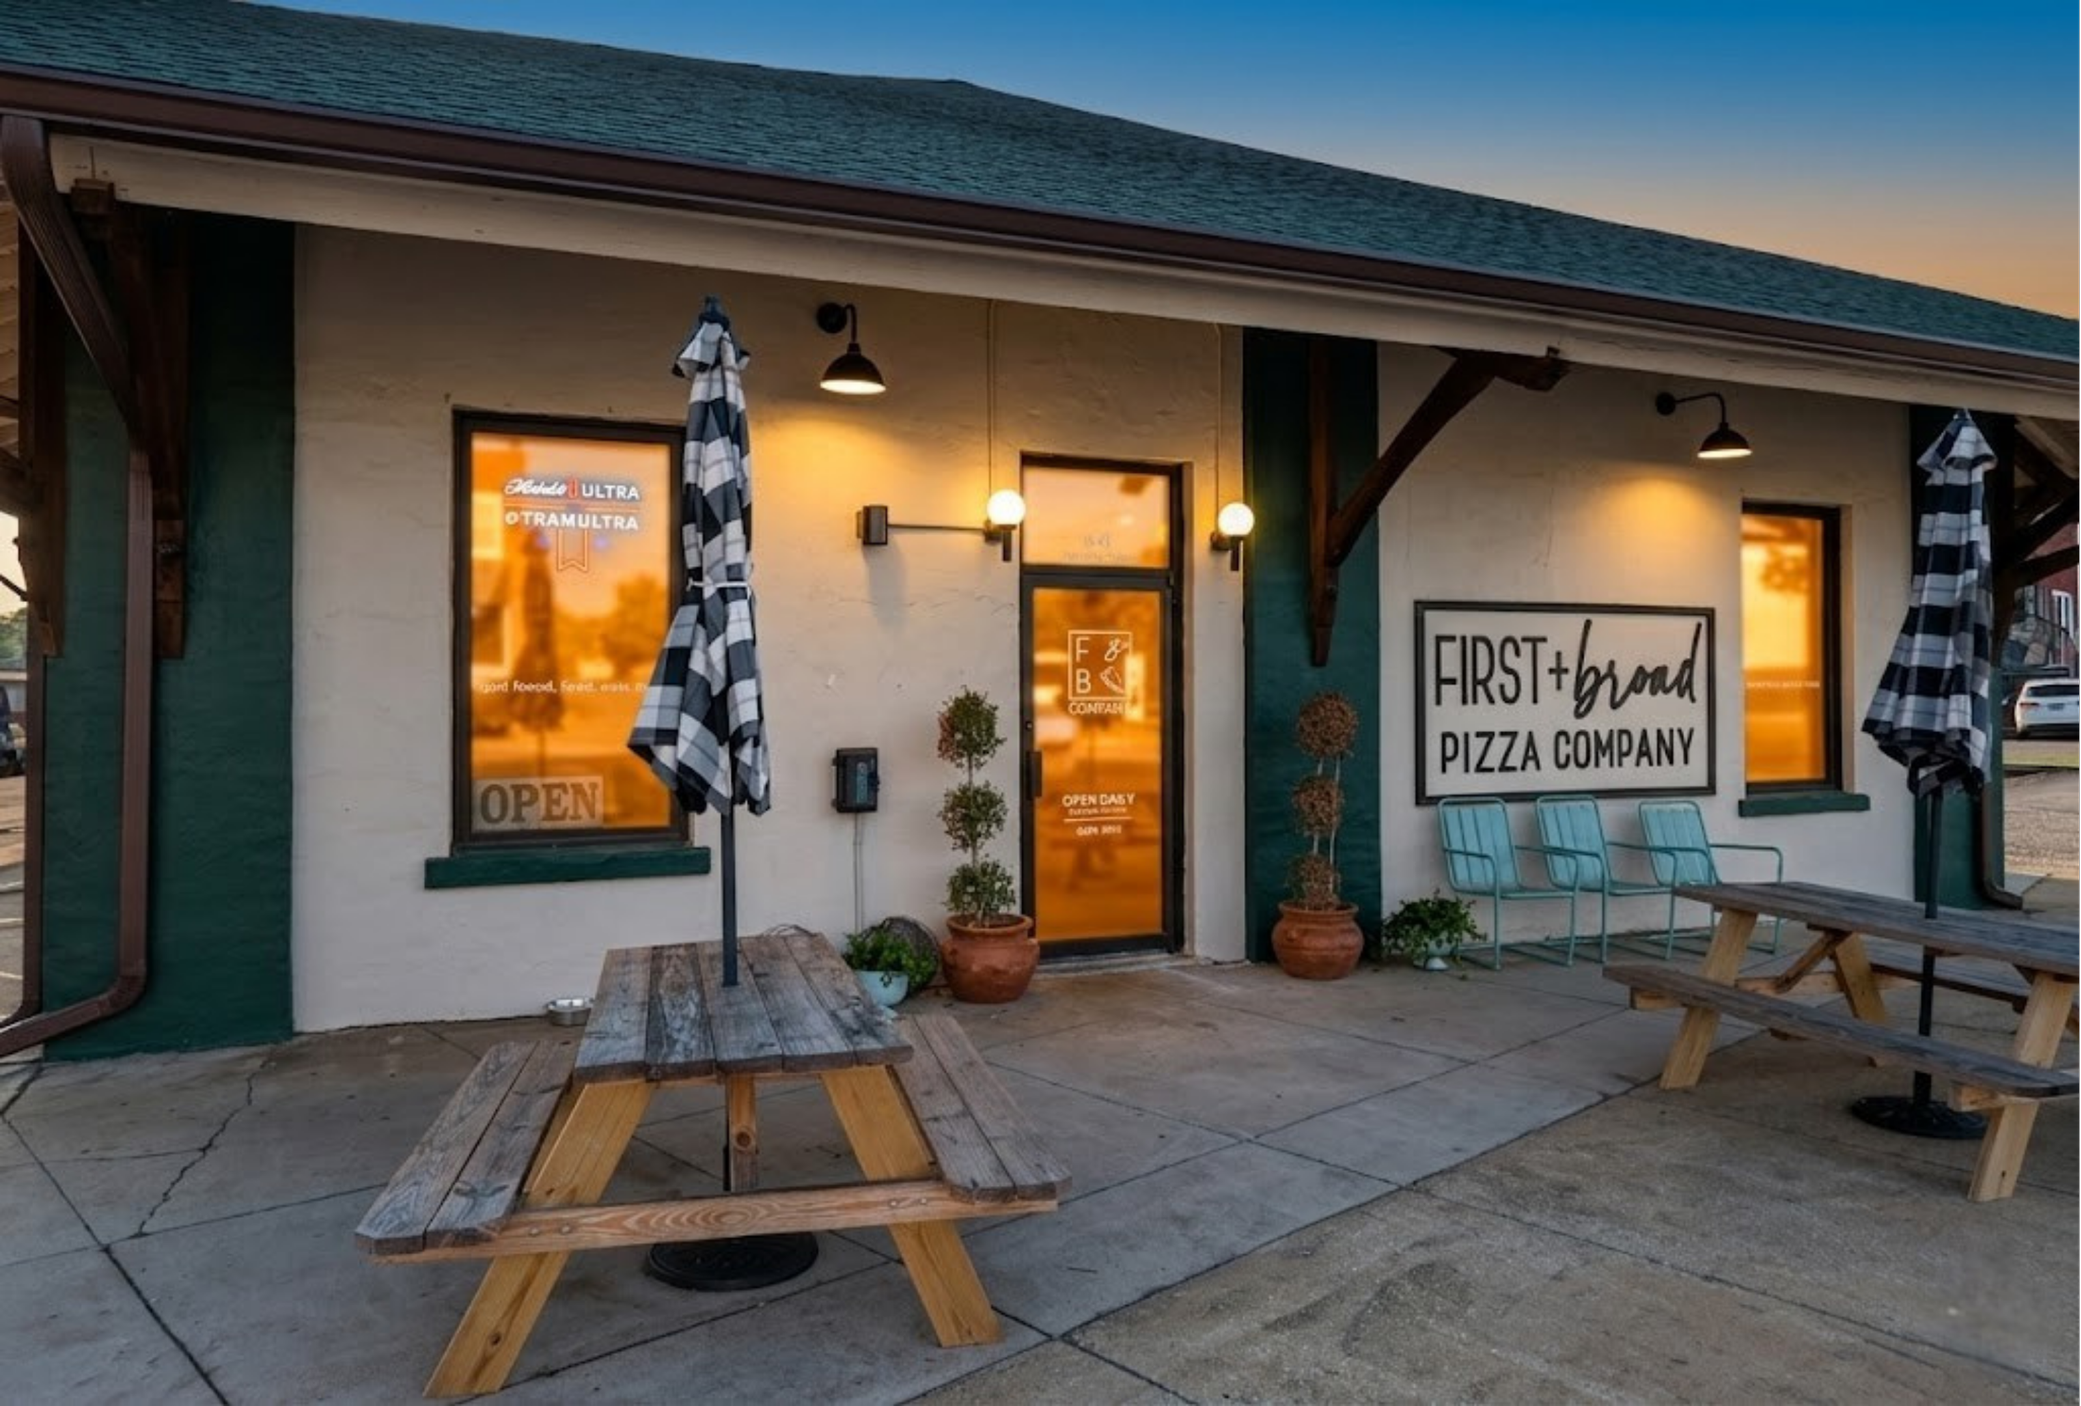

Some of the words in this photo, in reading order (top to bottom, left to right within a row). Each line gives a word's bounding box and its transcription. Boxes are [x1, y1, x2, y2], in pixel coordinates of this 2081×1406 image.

[581, 484, 641, 501] ULTRA
[1075, 636, 1091, 663] F
[1075, 667, 1092, 694] B
[1439, 730, 1542, 774] PIZZA
[1553, 727, 1695, 770] COMPANY
[479, 782, 599, 825] OPEN
[1062, 794, 1098, 808] OPEN
